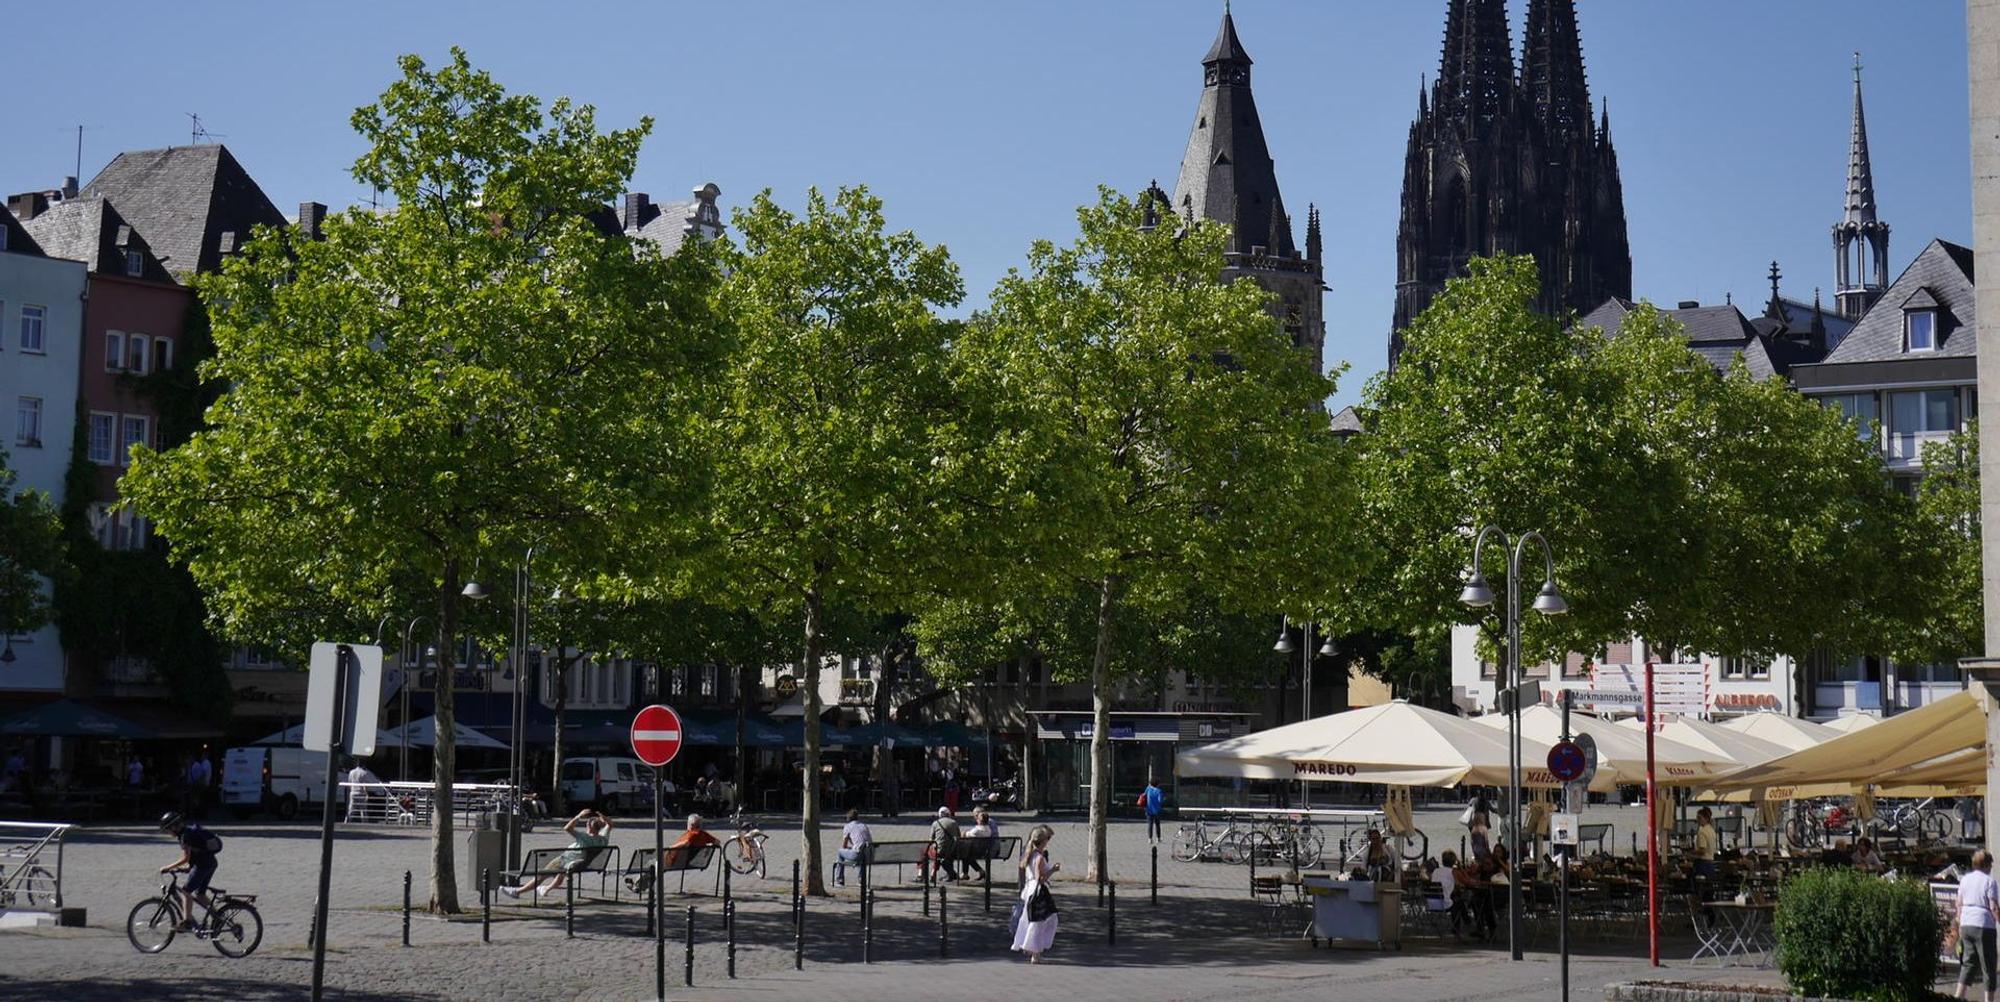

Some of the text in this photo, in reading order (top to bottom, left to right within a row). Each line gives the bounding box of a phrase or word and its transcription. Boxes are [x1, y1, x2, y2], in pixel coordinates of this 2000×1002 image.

[1572, 692, 1642, 703] Markmannsgasse
[1714, 693, 1776, 705] ALBERGO
[1294, 762, 1357, 776] MAREDO
